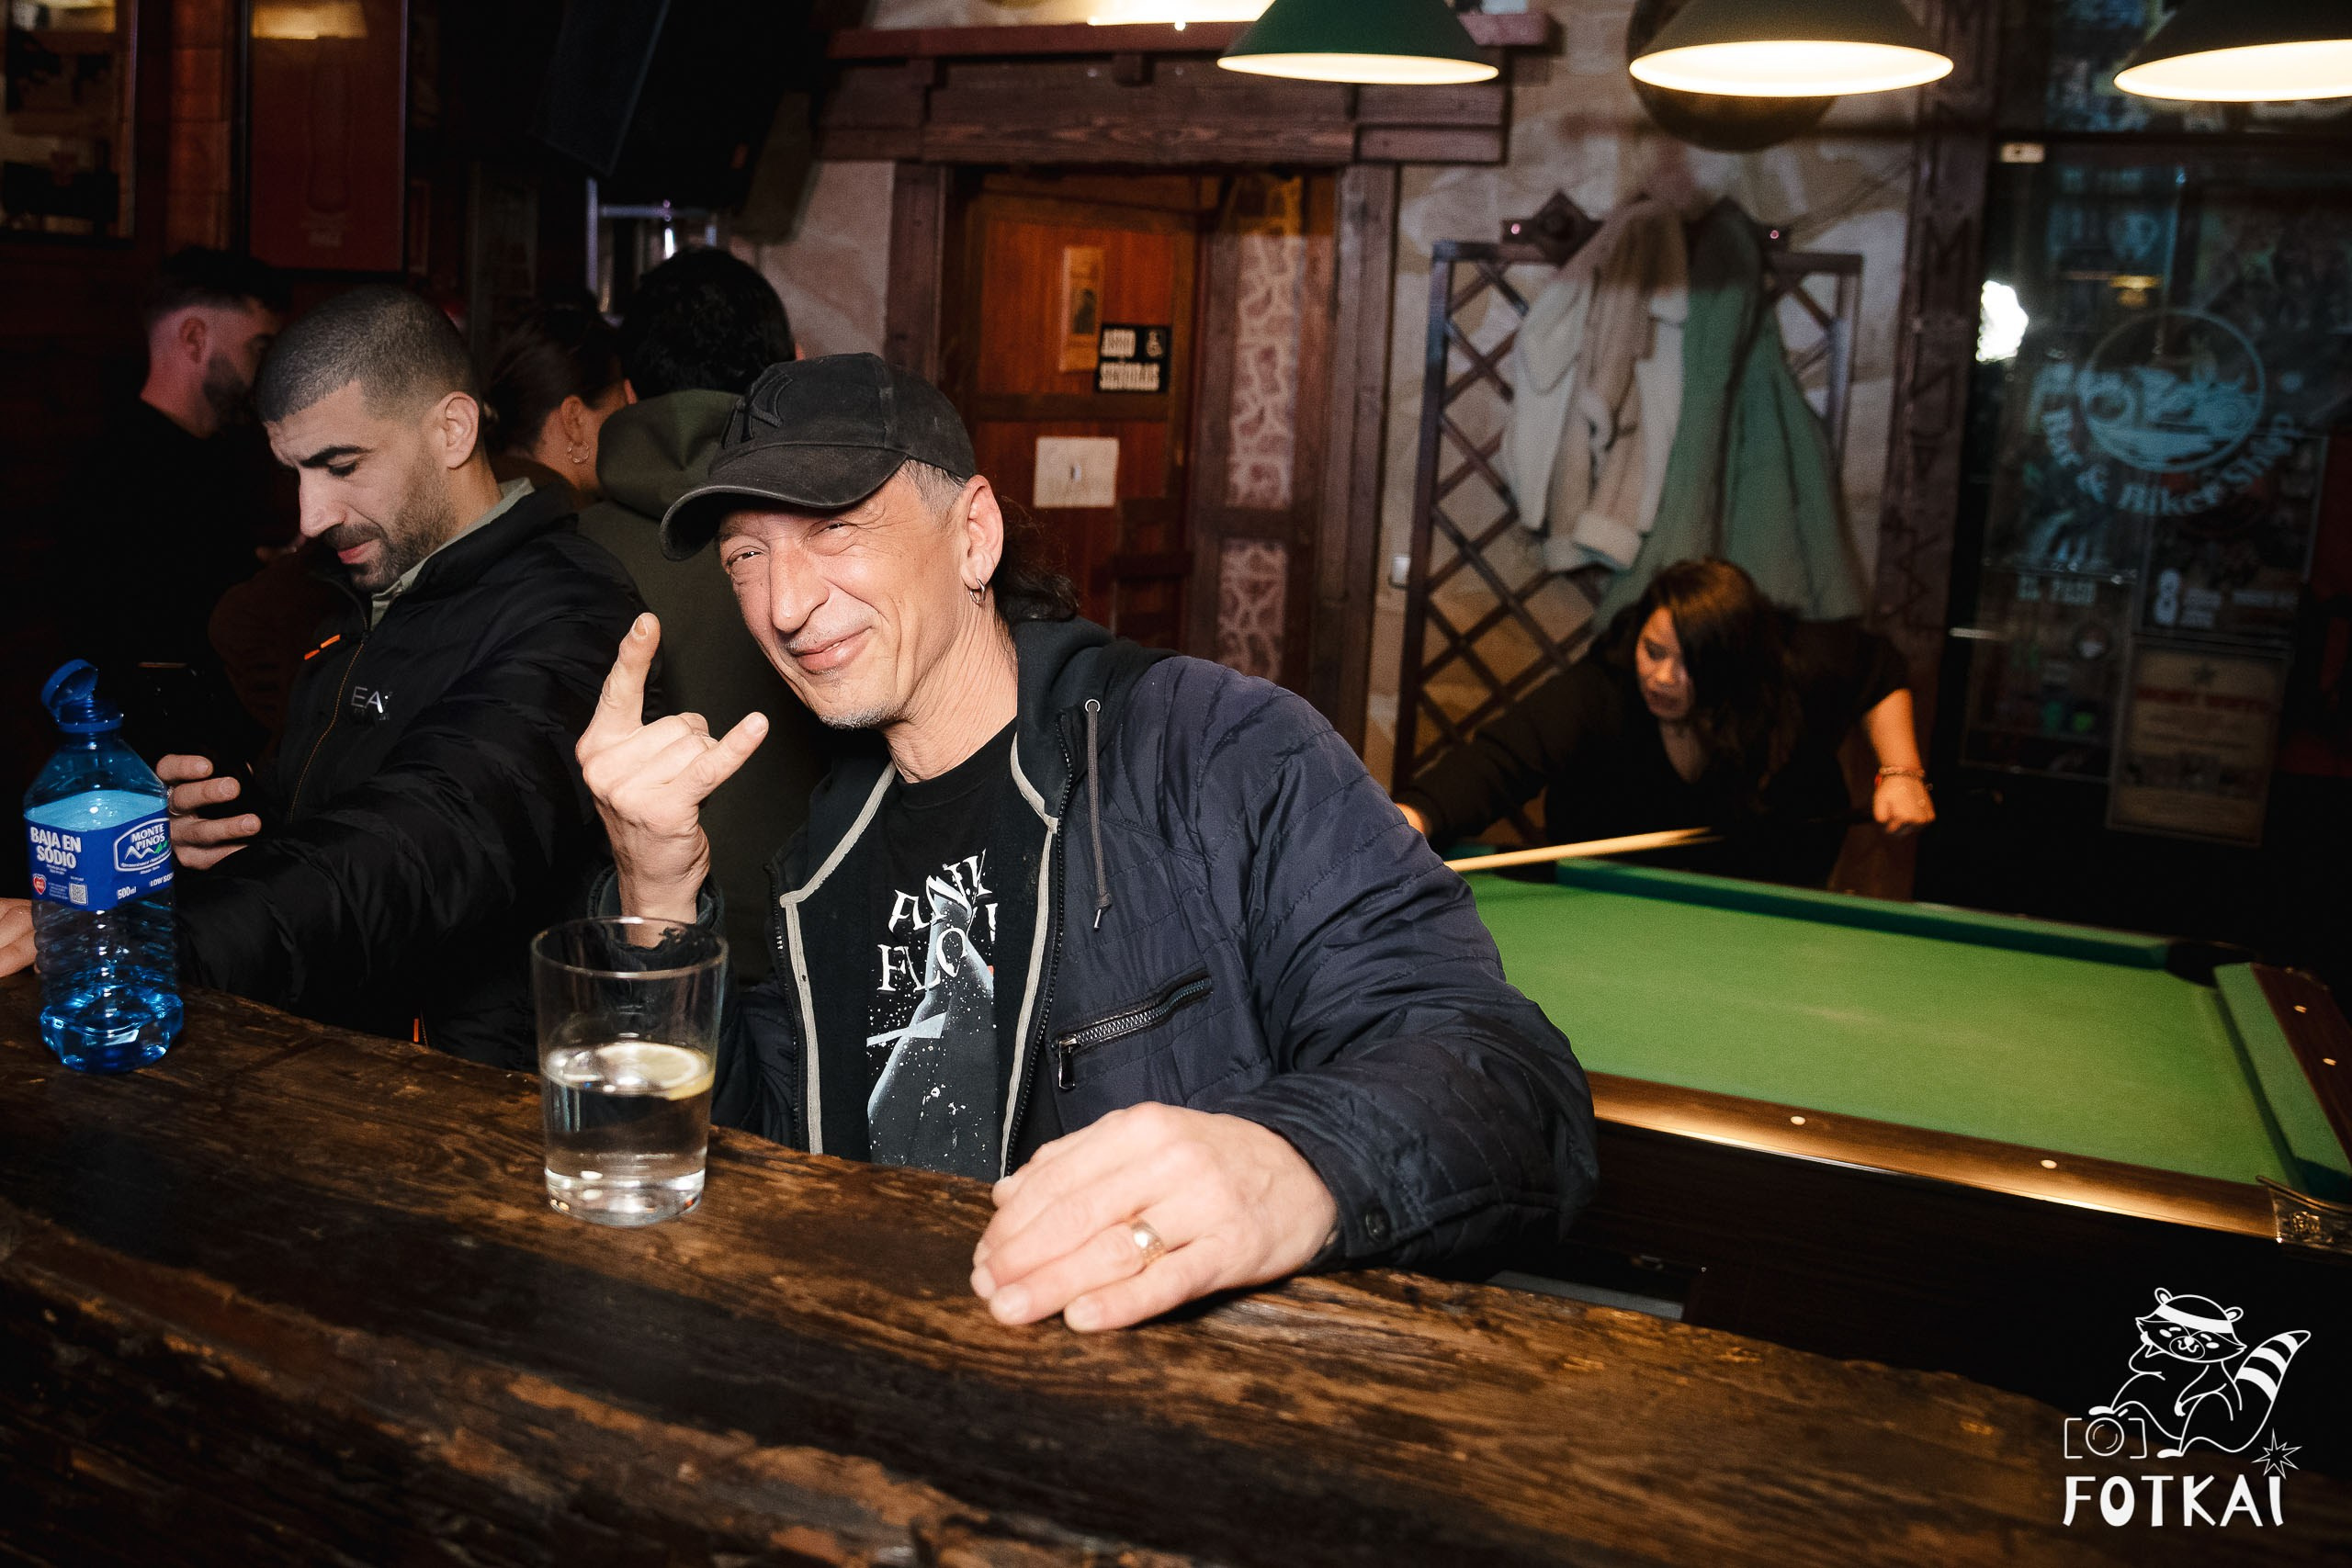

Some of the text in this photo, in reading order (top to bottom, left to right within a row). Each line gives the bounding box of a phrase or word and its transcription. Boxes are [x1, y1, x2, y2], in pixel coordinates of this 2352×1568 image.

[30, 828, 81, 852] BAJA EN
[131, 823, 165, 842] MONTE
[136, 833, 165, 851] PINOS
[37, 846, 76, 868] SODIO
[117, 886, 137, 900] 500ml
